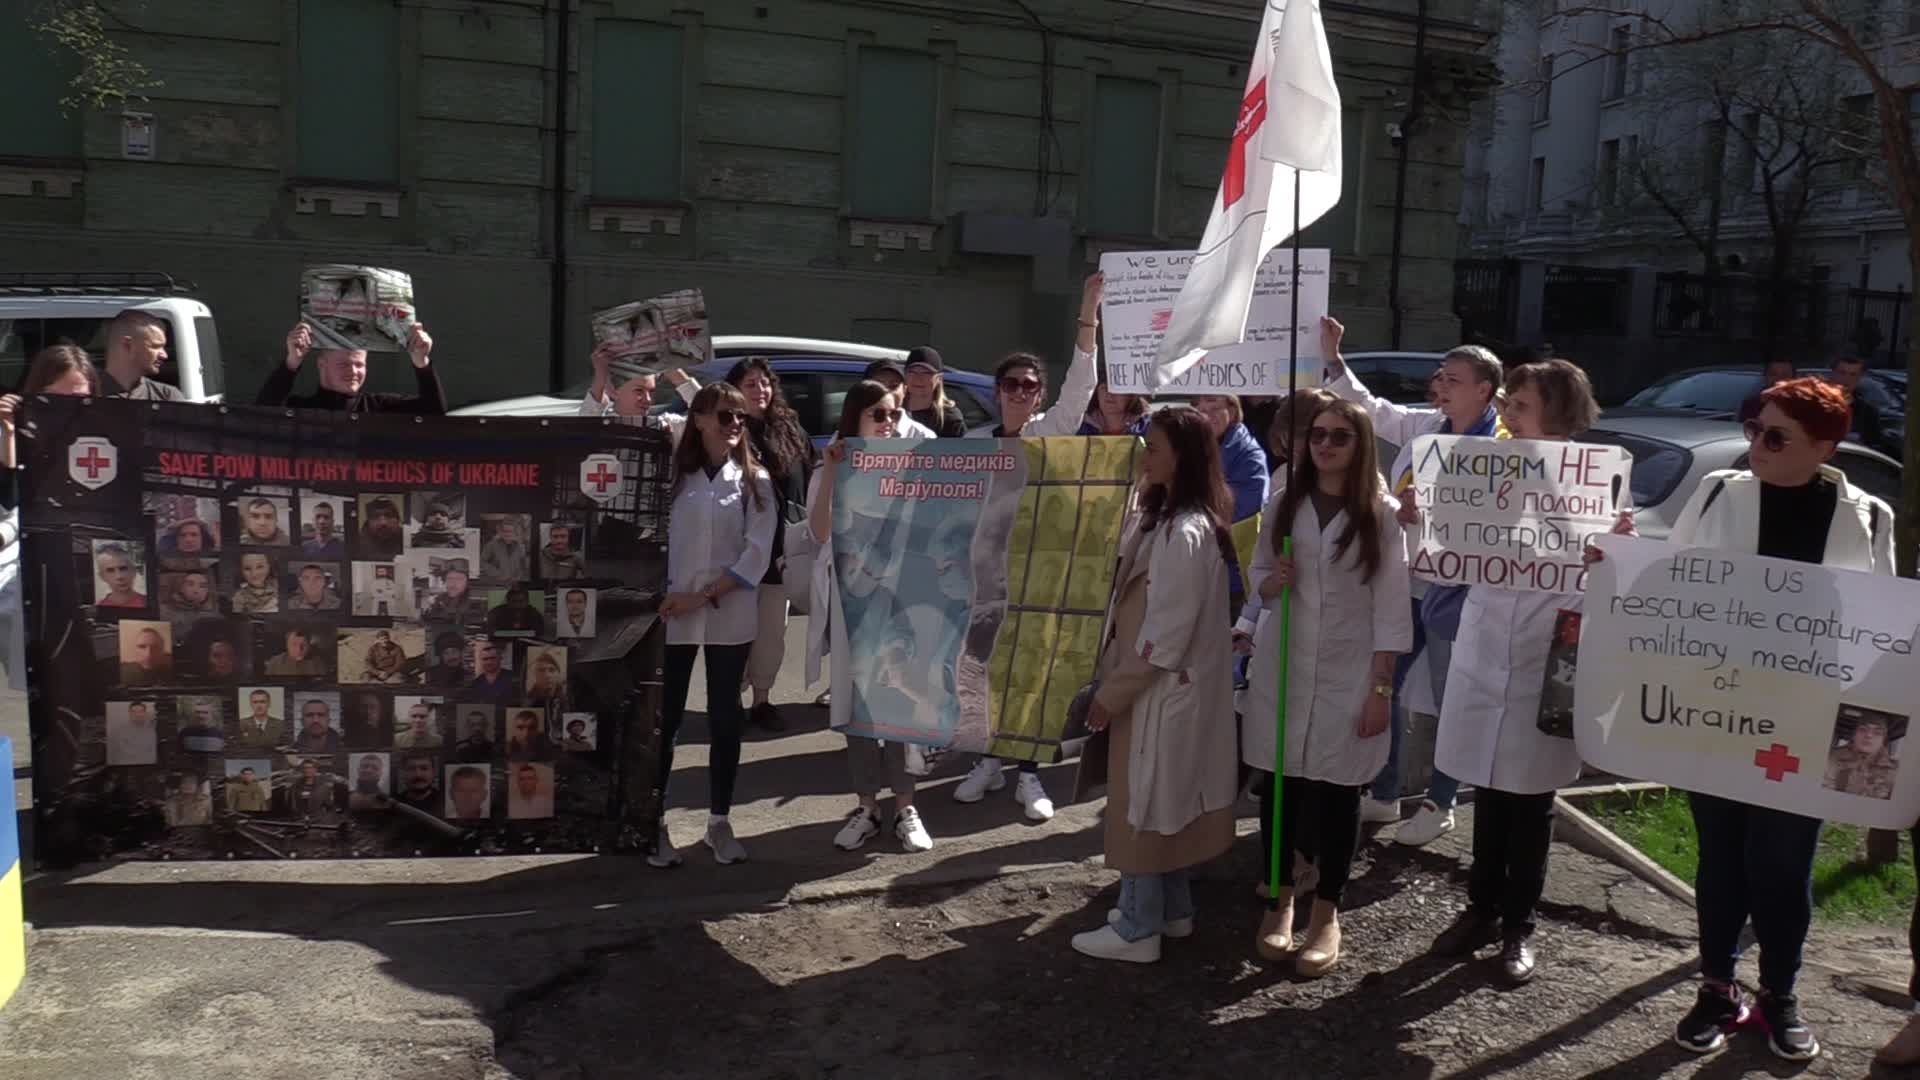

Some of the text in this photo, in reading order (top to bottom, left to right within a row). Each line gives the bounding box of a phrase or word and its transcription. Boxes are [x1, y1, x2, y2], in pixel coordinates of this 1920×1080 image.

[1200, 362, 1247, 388] MEDICS
[1251, 361, 1267, 386] OF
[159, 452, 540, 487] SAVE POW MILITARY MEDICS OF UKRAINE
[851, 450, 1017, 474] Врятуйте медиків
[1418, 439, 1609, 493] Лікарям НЕ
[879, 475, 985, 501] Маріуполя!
[1415, 485, 1484, 508] місце
[1496, 480, 1513, 510] в
[1669, 555, 1804, 593] HELP US
[1610, 595, 1920, 655] rescue the captured
[1628, 623, 1855, 682] military medics
[1713, 667, 1740, 690] of
[1640, 683, 1776, 735] Ukraine
